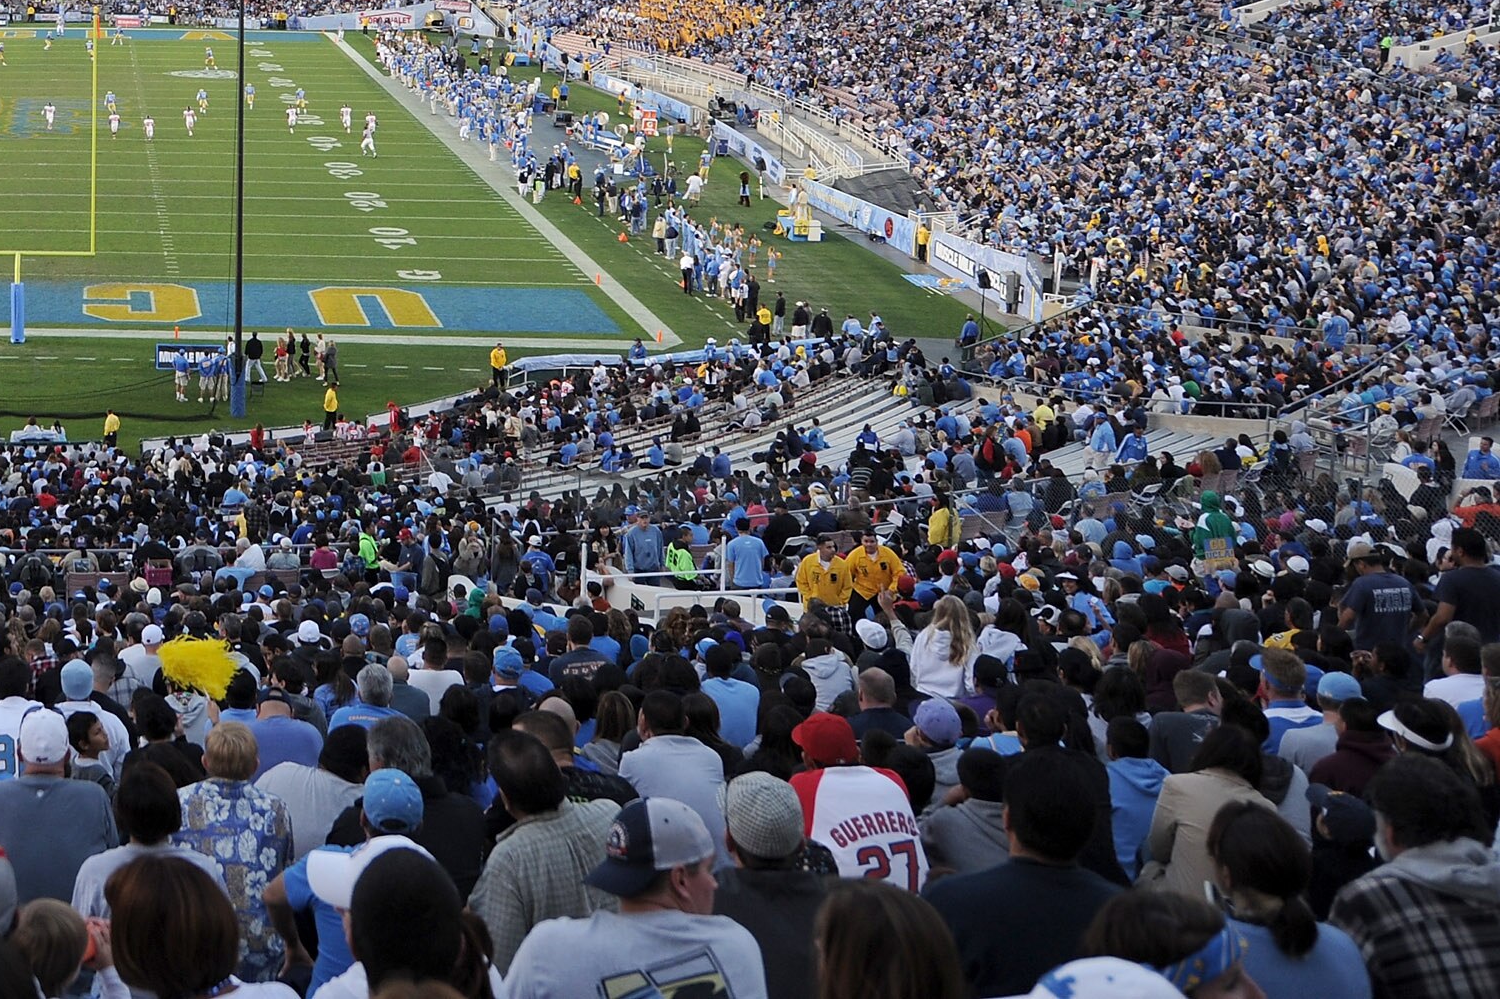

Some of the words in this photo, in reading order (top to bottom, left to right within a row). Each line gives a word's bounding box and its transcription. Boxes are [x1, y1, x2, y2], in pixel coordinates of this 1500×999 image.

[324, 162, 363, 176] 30
[344, 191, 389, 208] 20
[368, 227, 417, 245] 10
[935, 242, 959, 268] MUSCLE
[396, 269, 442, 279] G
[158, 351, 195, 363] MULE
[1209, 538, 1227, 549] GO
